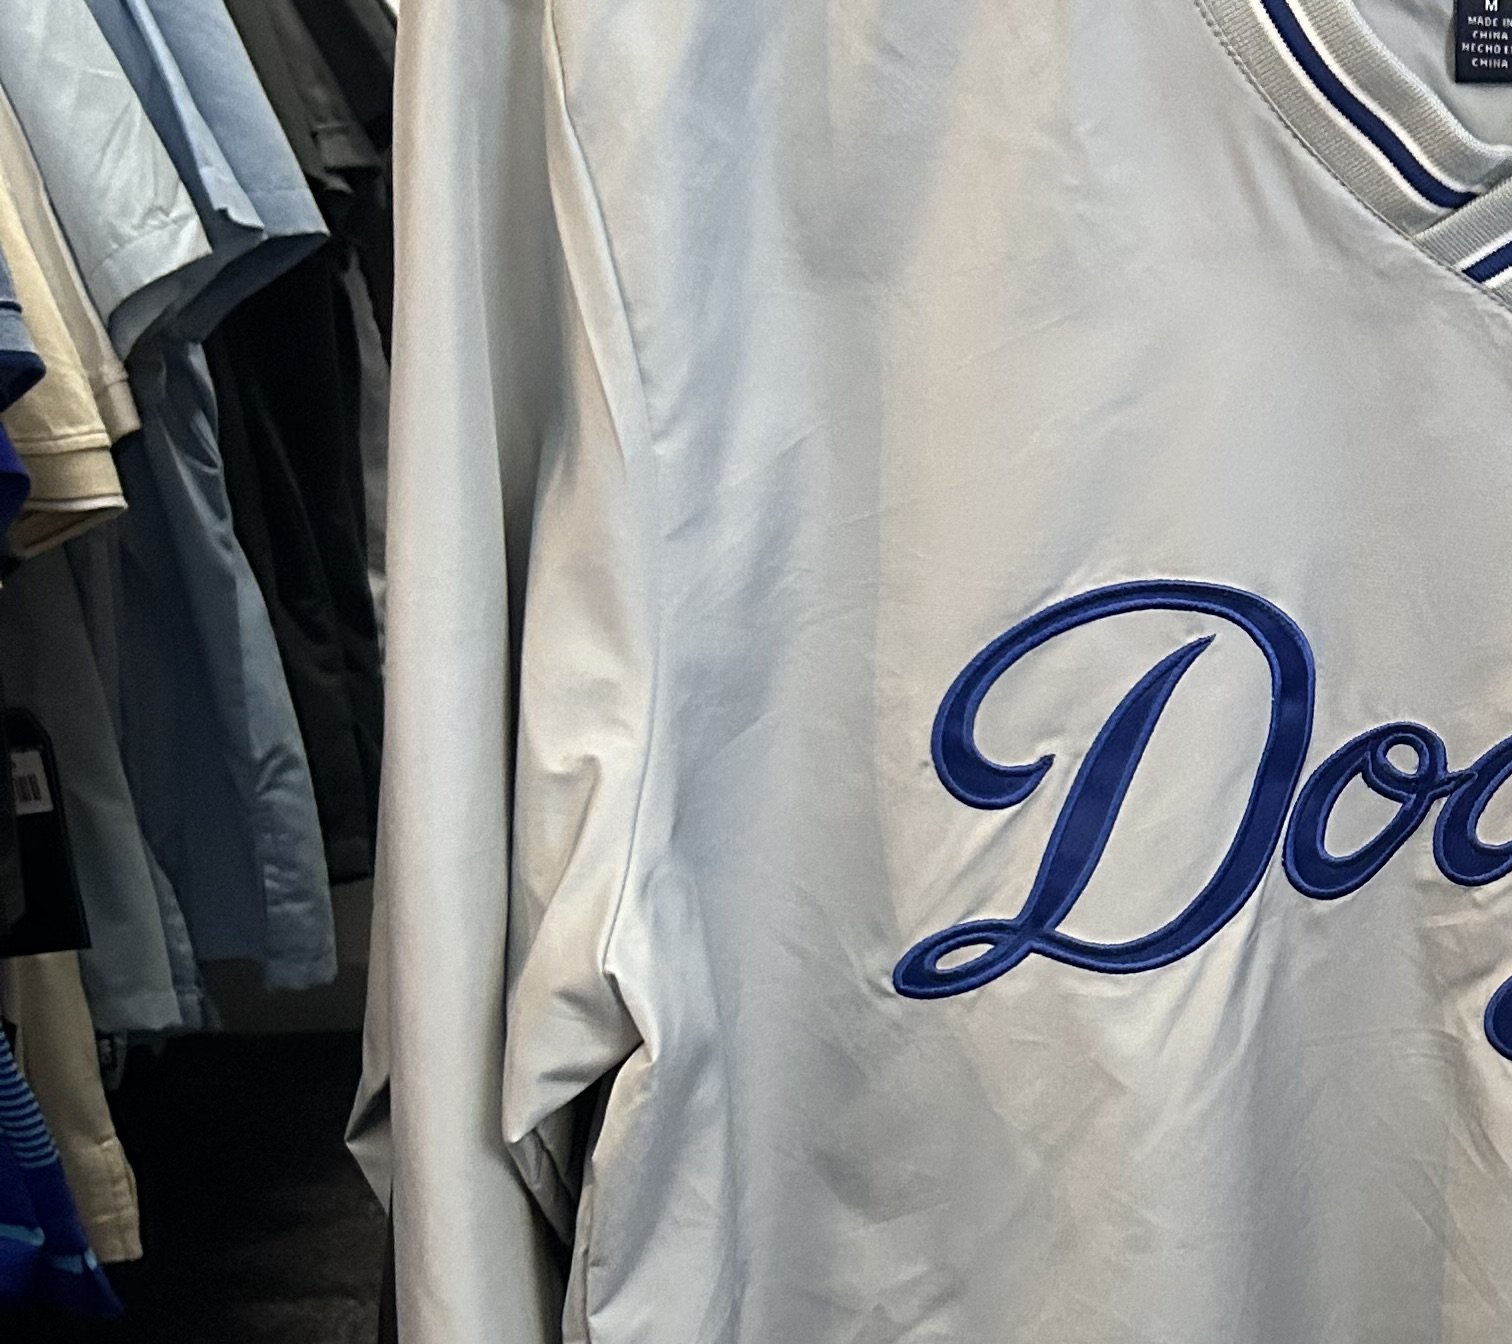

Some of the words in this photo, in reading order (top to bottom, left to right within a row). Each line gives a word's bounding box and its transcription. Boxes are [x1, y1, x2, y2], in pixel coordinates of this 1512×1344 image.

[1467, 16, 1499, 28] MADE
[1472, 30, 1509, 41] CHINA
[1461, 42, 1501, 55] HECHO
[1471, 57, 1509, 69] CHINA
